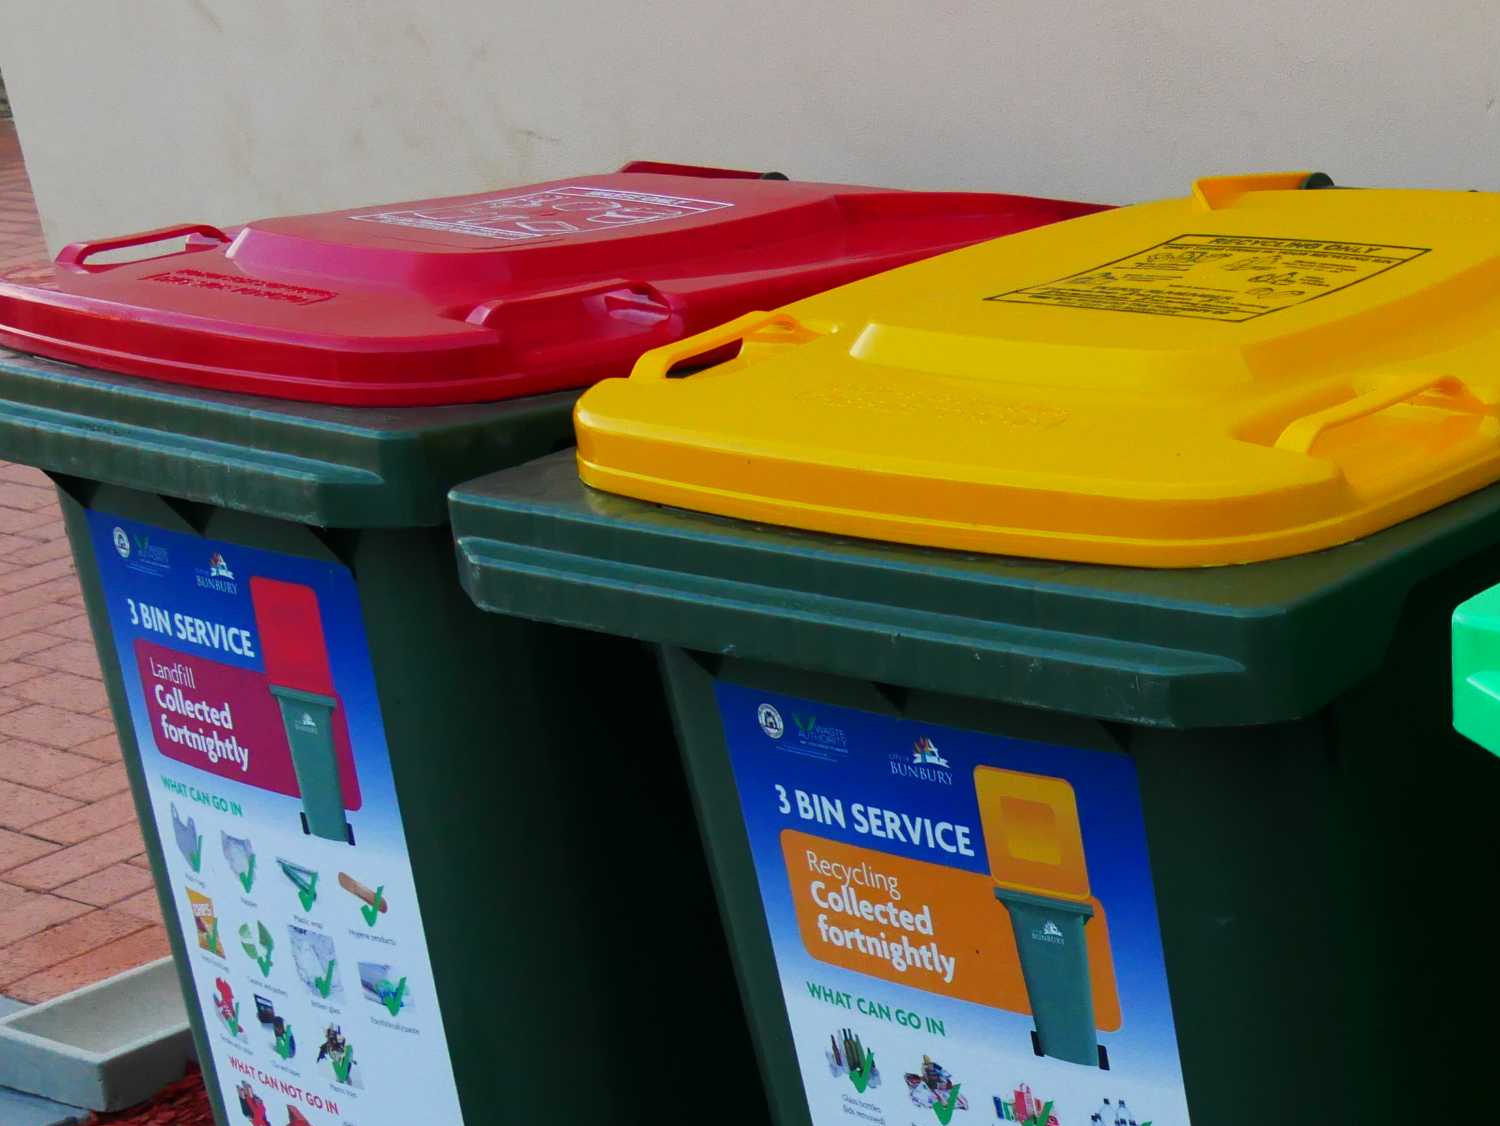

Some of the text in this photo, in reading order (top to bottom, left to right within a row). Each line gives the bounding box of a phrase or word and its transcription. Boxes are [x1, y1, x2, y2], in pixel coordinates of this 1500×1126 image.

[127, 598, 255, 658] 3 BIN SERVICE
[150, 657, 196, 689] Landfill
[154, 684, 233, 730] Collected
[161, 715, 249, 771] fortnightly
[160, 774, 243, 817] WHAT CAN GO IN
[889, 761, 953, 785] BUNBURY
[775, 784, 975, 856] 3 BIN SERVICE
[806, 849, 901, 900] Recycling
[811, 880, 934, 936] Collected
[818, 913, 956, 983] fortnightly
[806, 981, 946, 1037] WHAT CAN GO IN
[228, 1056, 255, 1078] WHAT
[258, 1070, 278, 1089] CAN
[280, 1079, 302, 1100] NOT
[304, 1091, 323, 1109] GO
[325, 1098, 340, 1115] IN
